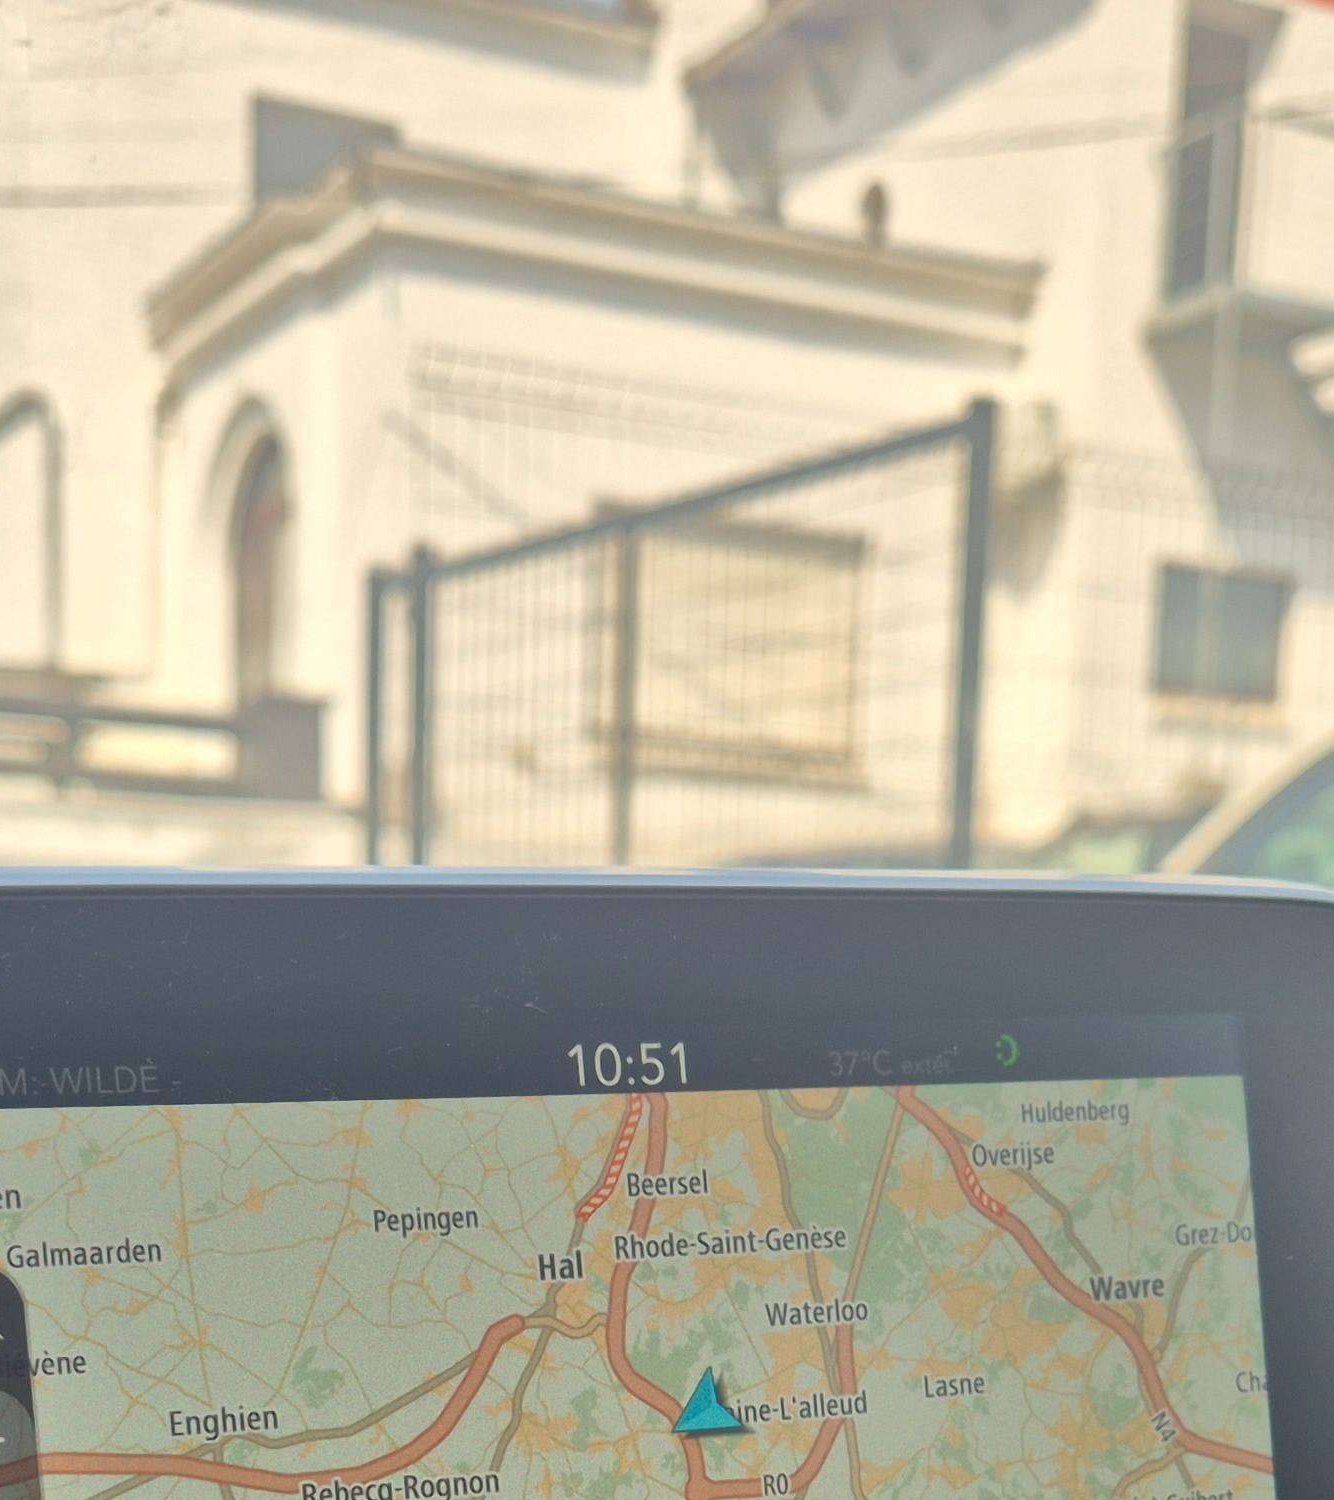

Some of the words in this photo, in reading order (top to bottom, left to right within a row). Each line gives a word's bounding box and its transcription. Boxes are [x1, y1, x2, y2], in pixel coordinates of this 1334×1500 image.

[568, 1042, 689, 1088] 10:51
[1020, 1100, 1130, 1125] Huldenberg
[972, 1142, 1055, 1170] Overijse
[626, 1170, 709, 1197] Beersel
[373, 1207, 479, 1238] Pepingen
[7, 1239, 162, 1269] Galmaarden
[615, 1226, 847, 1261] Rhode-Saint-Genèse
[537, 1250, 584, 1281] Hal
[1089, 1275, 1165, 1302] Wavre
[765, 1301, 868, 1326] Waterloo
[924, 1374, 985, 1399] Lasne
[169, 1405, 279, 1442] Enghien
